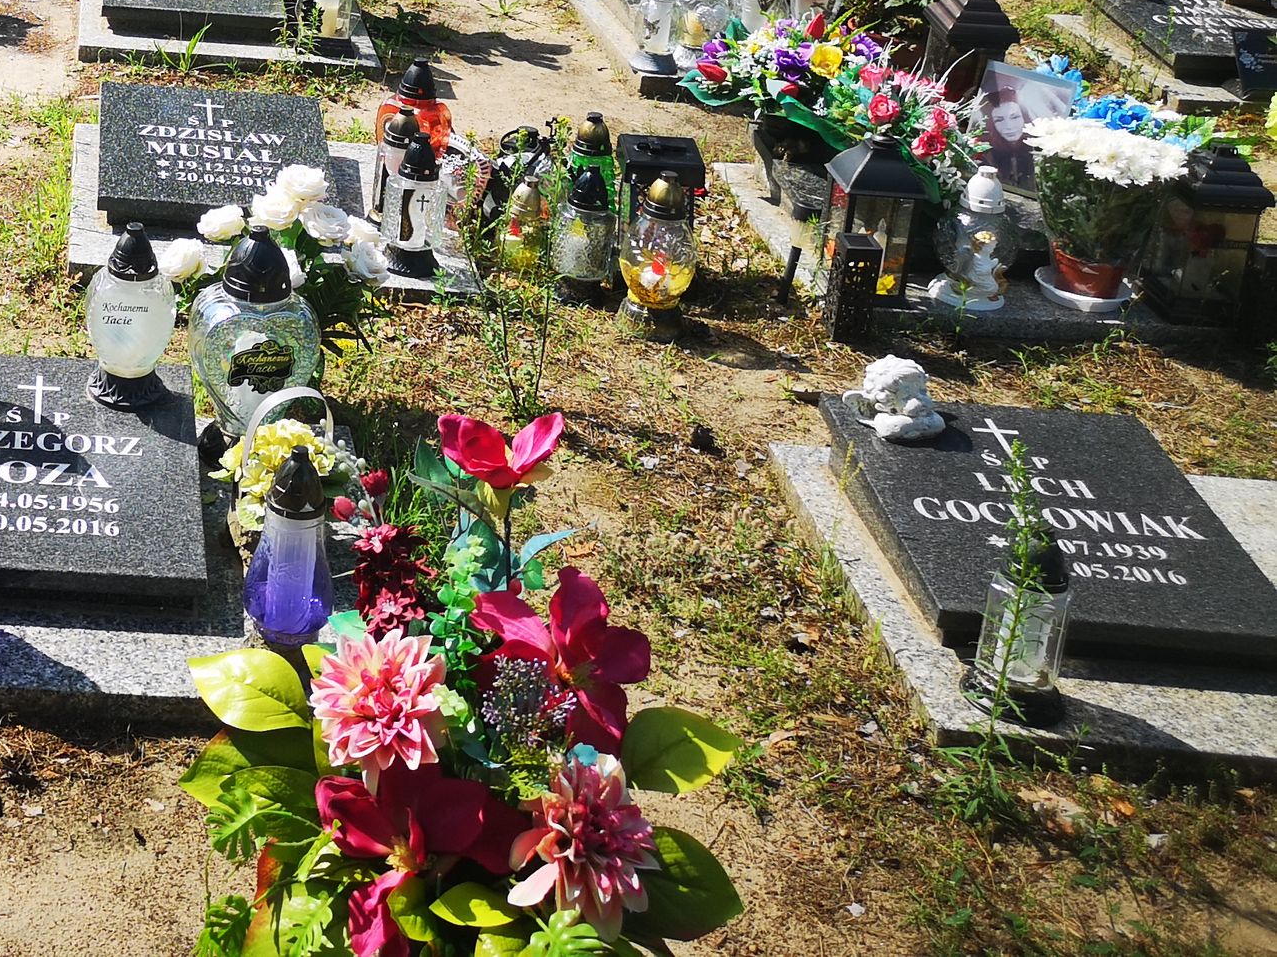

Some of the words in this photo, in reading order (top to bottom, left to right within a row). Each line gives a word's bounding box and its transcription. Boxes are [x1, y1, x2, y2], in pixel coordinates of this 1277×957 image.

[221, 119, 234, 128] P
[146, 140, 282, 164] MUSIAŁ
[176, 159, 274, 177] 19.12.1957
[102, 301, 149, 313] Kochanemu
[102, 315, 133, 326] Tacie
[236, 353, 290, 365] Kochanemu
[246, 362, 277, 374] Tacie
[5, 407, 22, 423] Ś
[53, 412, 70, 426] P
[980, 449, 1002, 467] Ś
[1031, 456, 1050, 470] P
[1069, 561, 1188, 586] .05.2016
